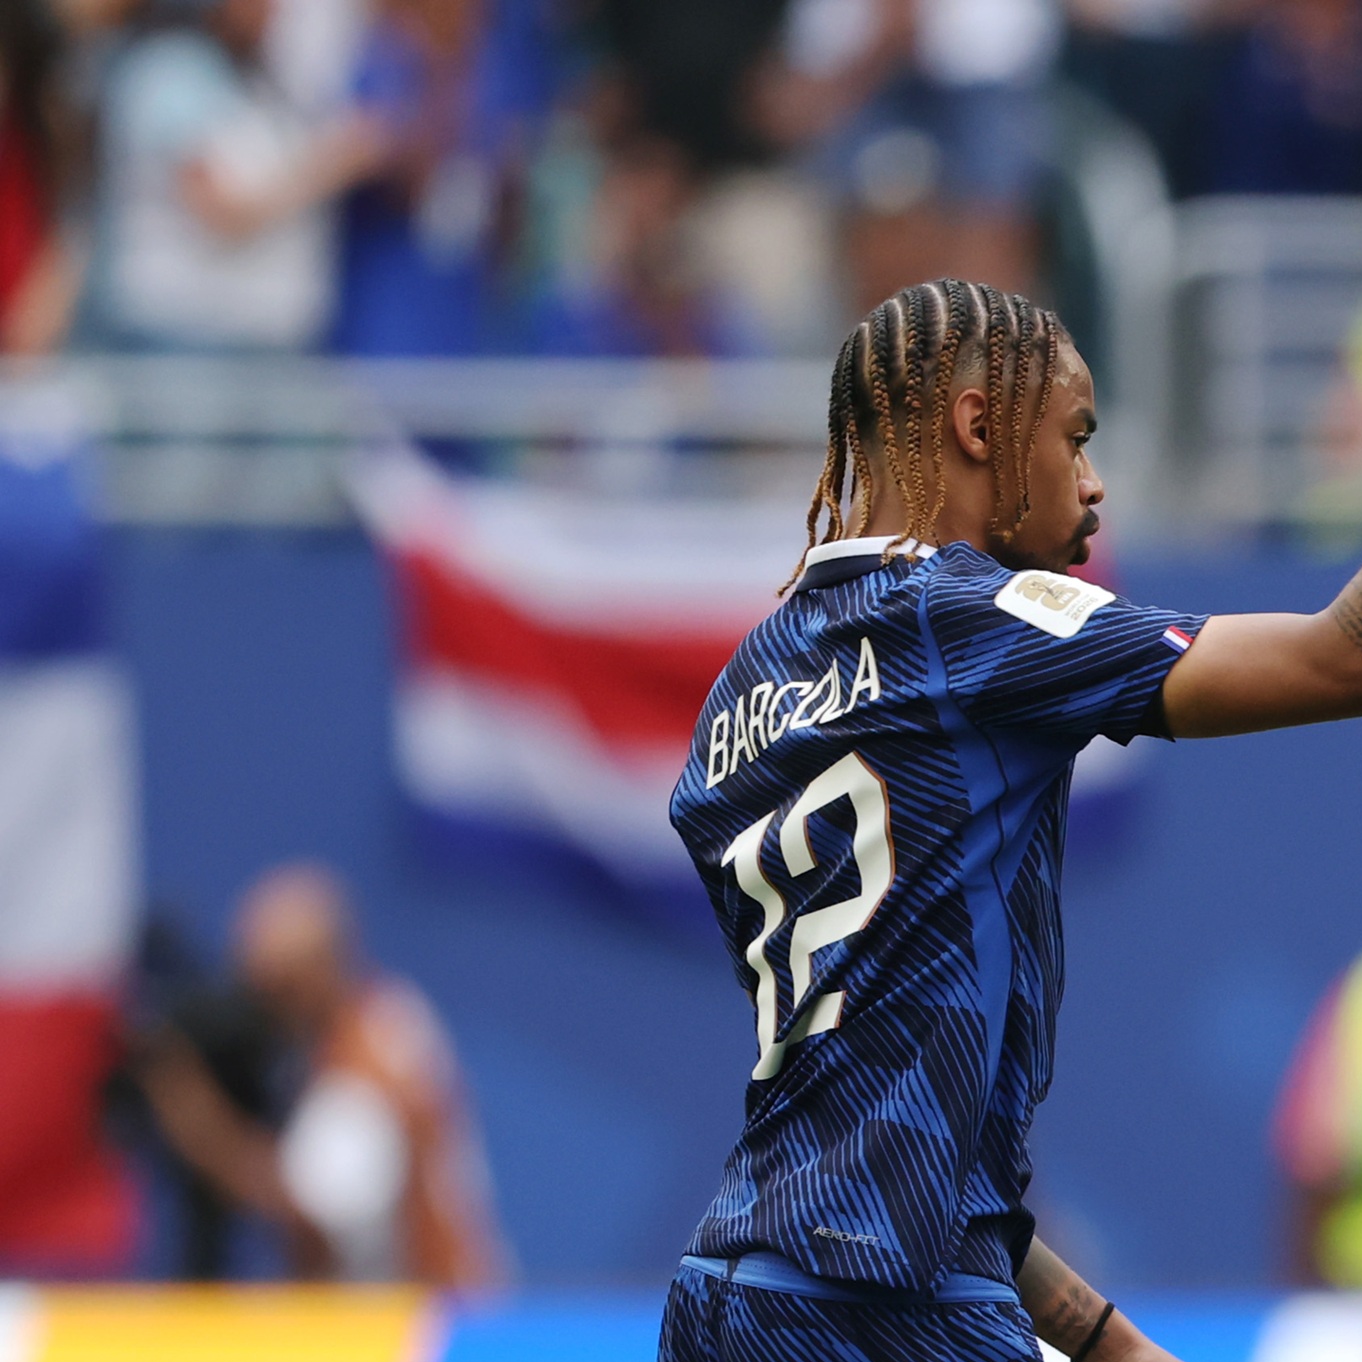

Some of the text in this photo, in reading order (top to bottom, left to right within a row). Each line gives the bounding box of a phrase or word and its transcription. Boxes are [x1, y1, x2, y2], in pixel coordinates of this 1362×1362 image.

[706, 636, 882, 790] BARCOLA
[720, 750, 895, 1081] 12
[813, 1226, 880, 1246] AERO-FIT
